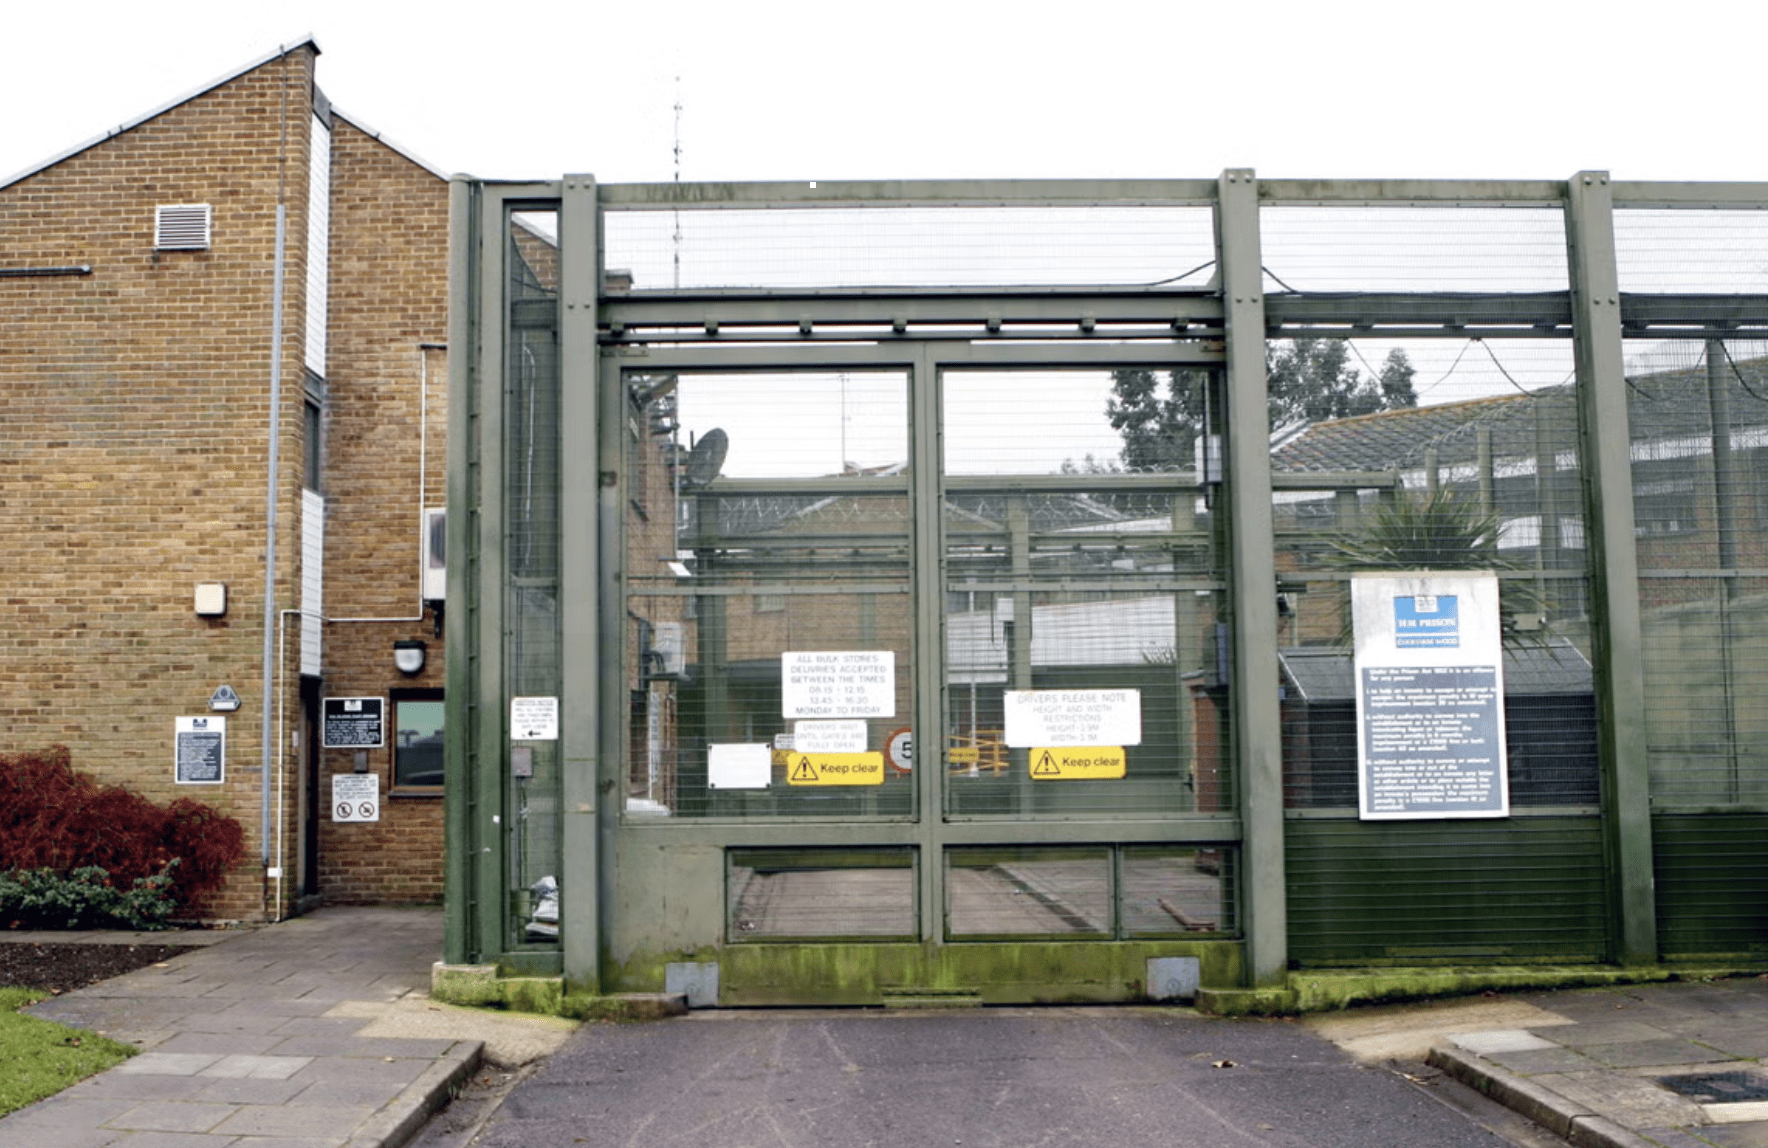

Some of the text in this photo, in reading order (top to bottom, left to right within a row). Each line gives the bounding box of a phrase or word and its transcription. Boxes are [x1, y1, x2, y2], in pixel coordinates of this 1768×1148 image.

[797, 655, 879, 663] ALL BULK STORES
[840, 665, 887, 673] ACCEPTED
[839, 675, 854, 683] THE
[859, 675, 885, 683] TIMES
[1017, 692, 1126, 704] DRIVERS PLEASE NOTE
[851, 706, 880, 714] FRIDAY
[1033, 704, 1112, 713] HEIGHT AND WIDTH
[1043, 714, 1102, 722] RESTRICTIONS
[901, 741, 912, 759] 5
[1062, 756, 1120, 768] Keep clear
[820, 763, 878, 775] Keep clear
